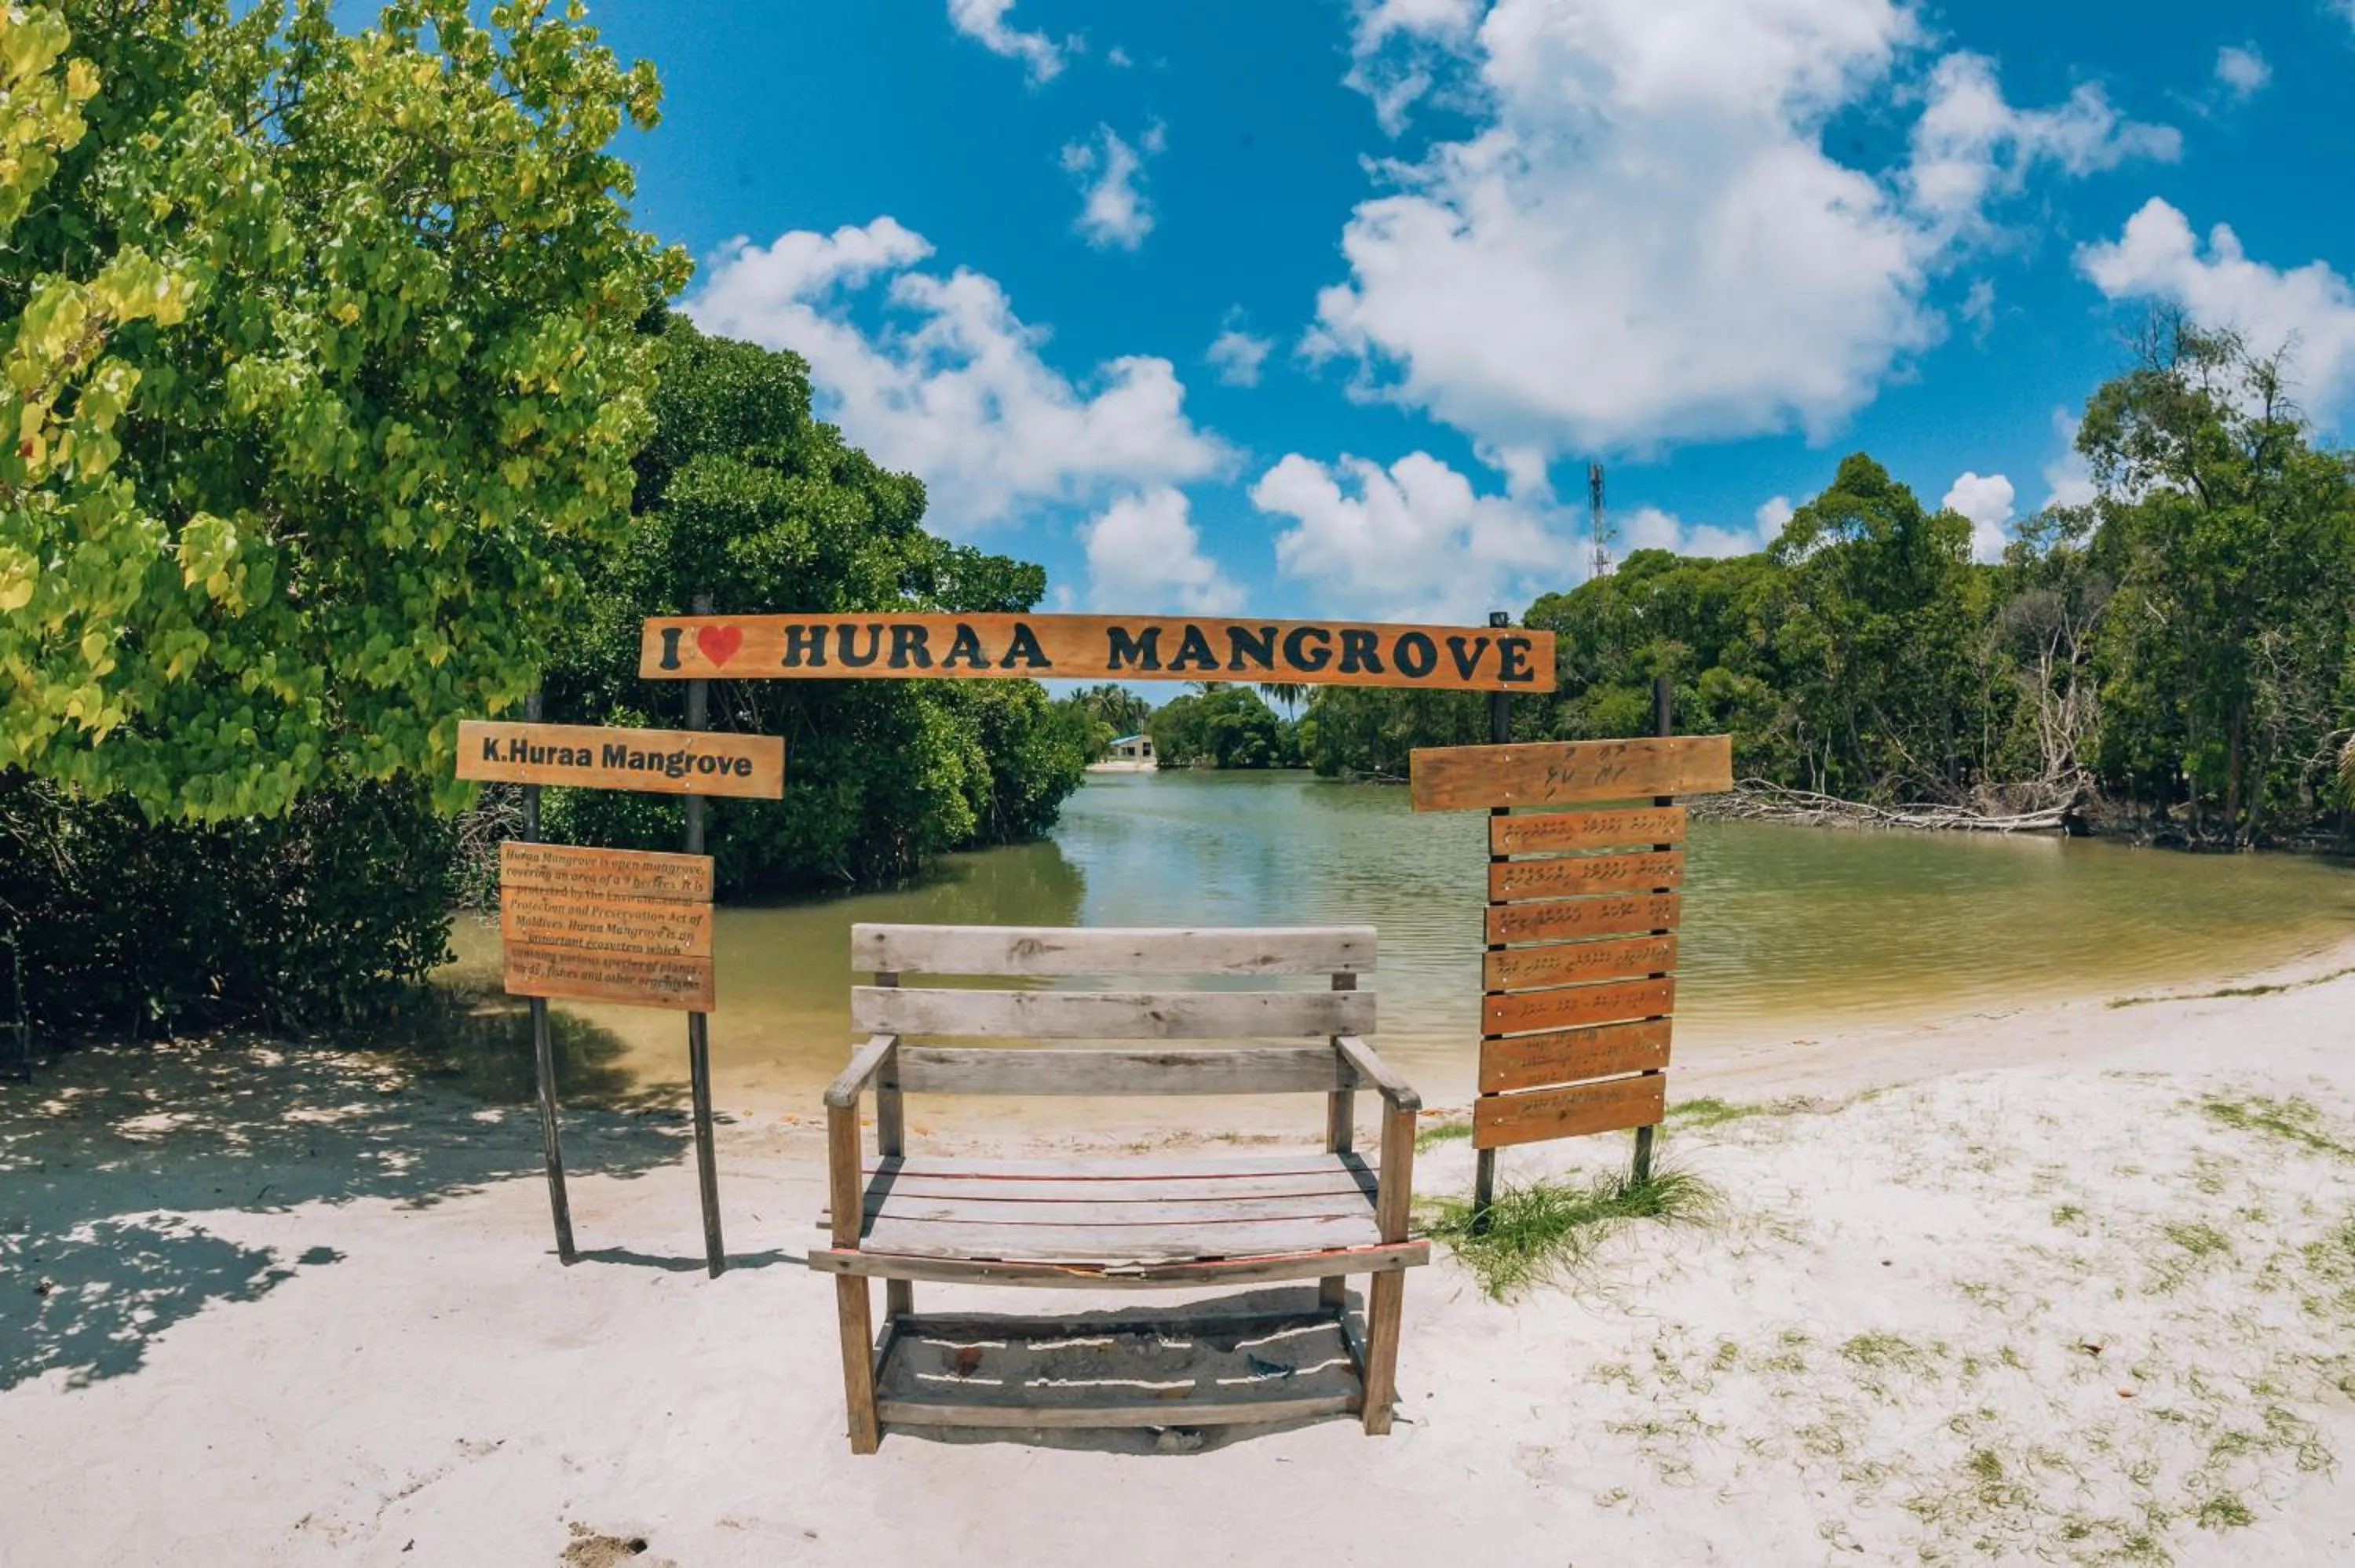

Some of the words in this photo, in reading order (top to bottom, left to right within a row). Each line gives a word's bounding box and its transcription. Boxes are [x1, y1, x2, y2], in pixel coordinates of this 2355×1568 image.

[659, 627, 683, 671] I
[780, 622, 1053, 669] HURAA
[1106, 624, 1536, 684] MANGROVE
[483, 736, 593, 768] K.Huraa
[601, 742, 753, 779] Mangrove
[506, 848, 539, 862] Huraa
[543, 851, 597, 868] Mangrove
[506, 867, 551, 881] covering
[600, 873, 612, 885] of
[571, 886, 584, 901] by
[585, 888, 604, 900] the
[568, 903, 588, 915] and
[590, 906, 666, 922] Preservation
[668, 912, 686, 924] Act
[688, 913, 704, 926] of
[568, 921, 604, 933] Huraa
[606, 924, 663, 939] Mangrove
[646, 943, 681, 955] which
[581, 968, 602, 982] and
[604, 972, 636, 985] other
